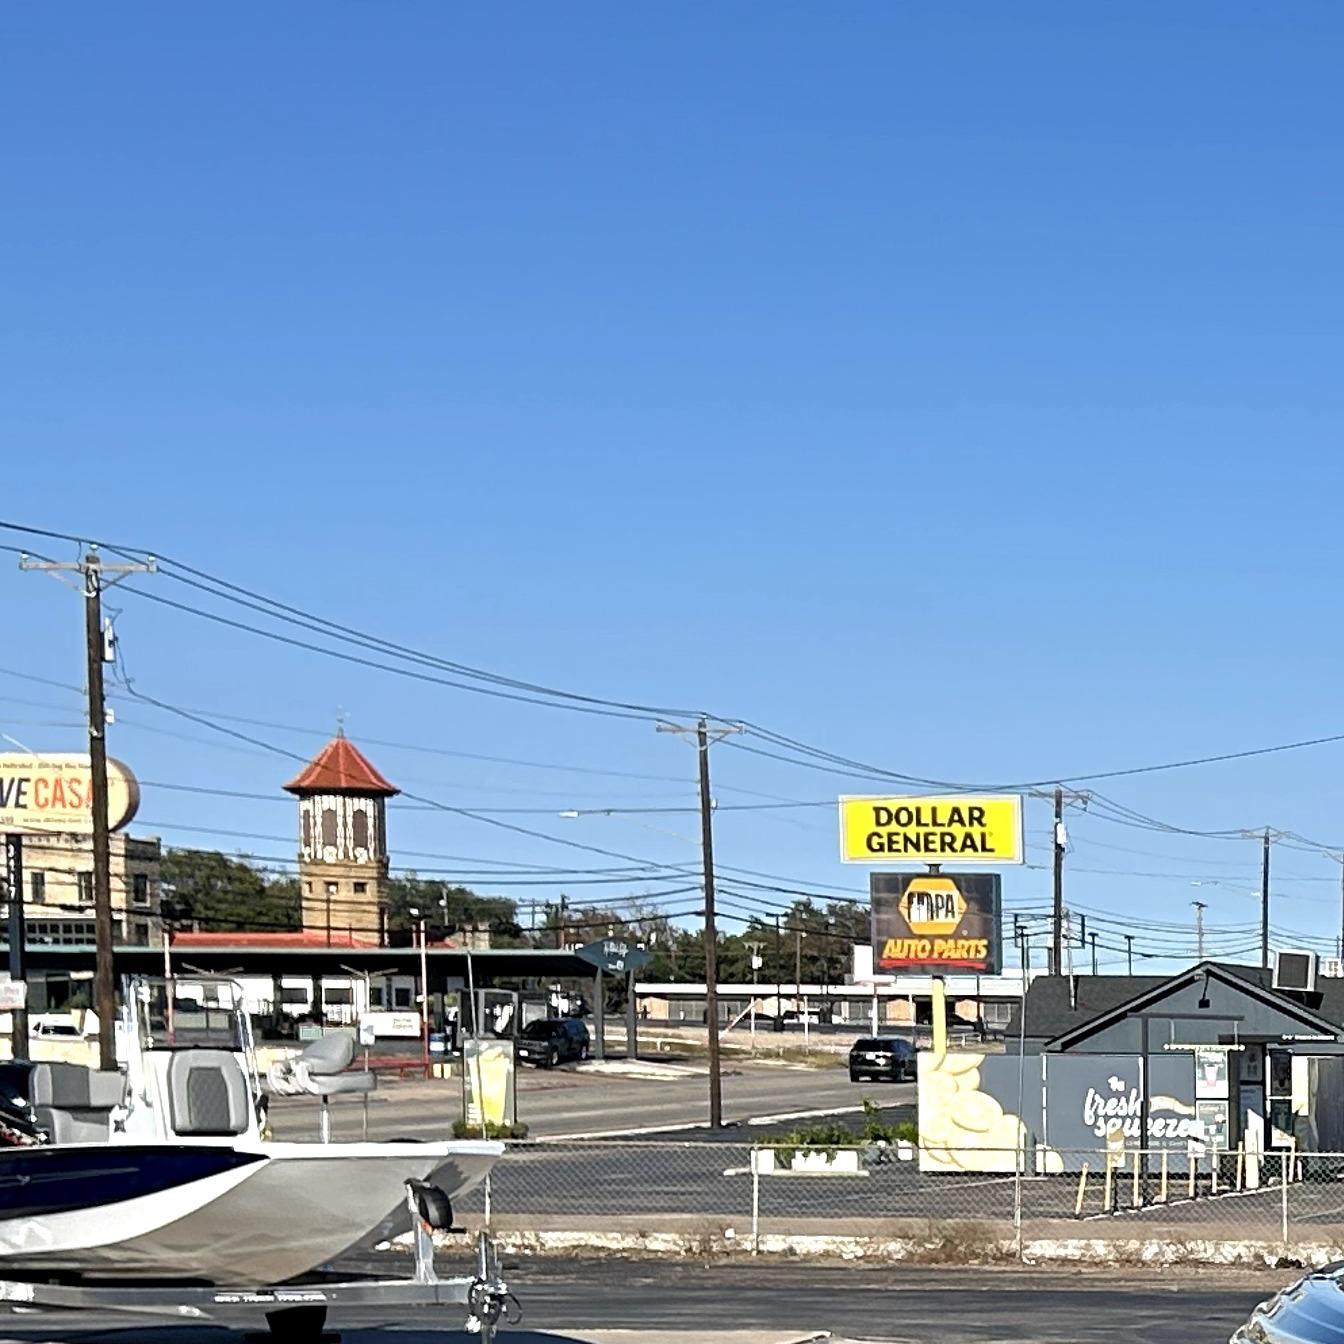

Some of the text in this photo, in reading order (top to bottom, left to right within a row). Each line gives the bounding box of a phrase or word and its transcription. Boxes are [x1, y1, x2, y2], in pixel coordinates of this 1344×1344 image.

[873, 806, 988, 828] DOLLAR
[866, 831, 996, 853] GENERAL
[882, 939, 989, 960] AUTO PARTS
